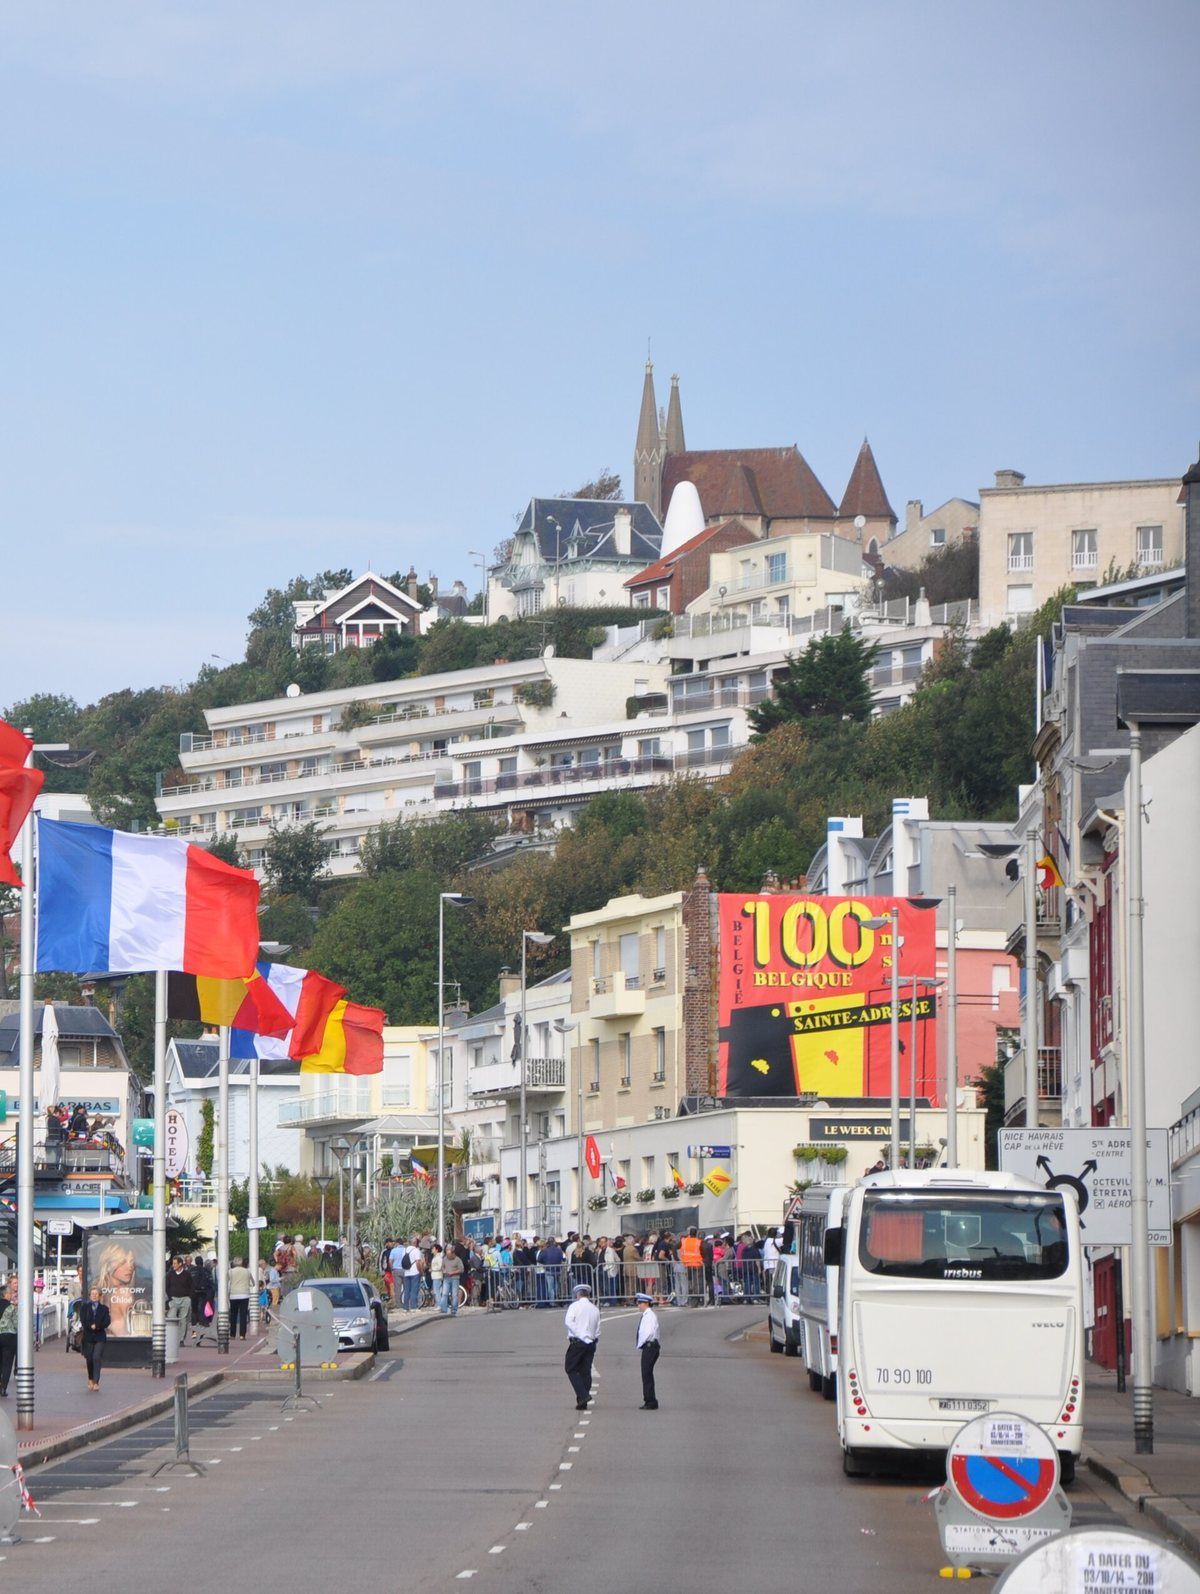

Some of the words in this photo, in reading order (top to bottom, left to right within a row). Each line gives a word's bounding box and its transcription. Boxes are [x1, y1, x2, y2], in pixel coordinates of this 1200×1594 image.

[744, 901, 874, 966] 100
[753, 972, 853, 989] BELGIQUE
[58, 1101, 112, 1110] ARIBAS
[824, 1125, 838, 1135] LE
[839, 1125, 872, 1135] WEEK
[168, 1115, 177, 1167] HOTEL
[1004, 1132, 1024, 1140] NICE
[1028, 1132, 1064, 1141] HAVRAIS
[1004, 1142, 1022, 1151] CAP
[1107, 1140, 1152, 1148] ADREE
[1093, 1178, 1131, 1186] OCTEVIL
[1107, 1199, 1154, 1208] AÉROT
[877, 1368, 889, 1383] 70
[894, 1369, 911, 1384] 90
[916, 1369, 932, 1384] 100
[1098, 1553, 1132, 1568] DATER
[1135, 1555, 1150, 1569] DU
